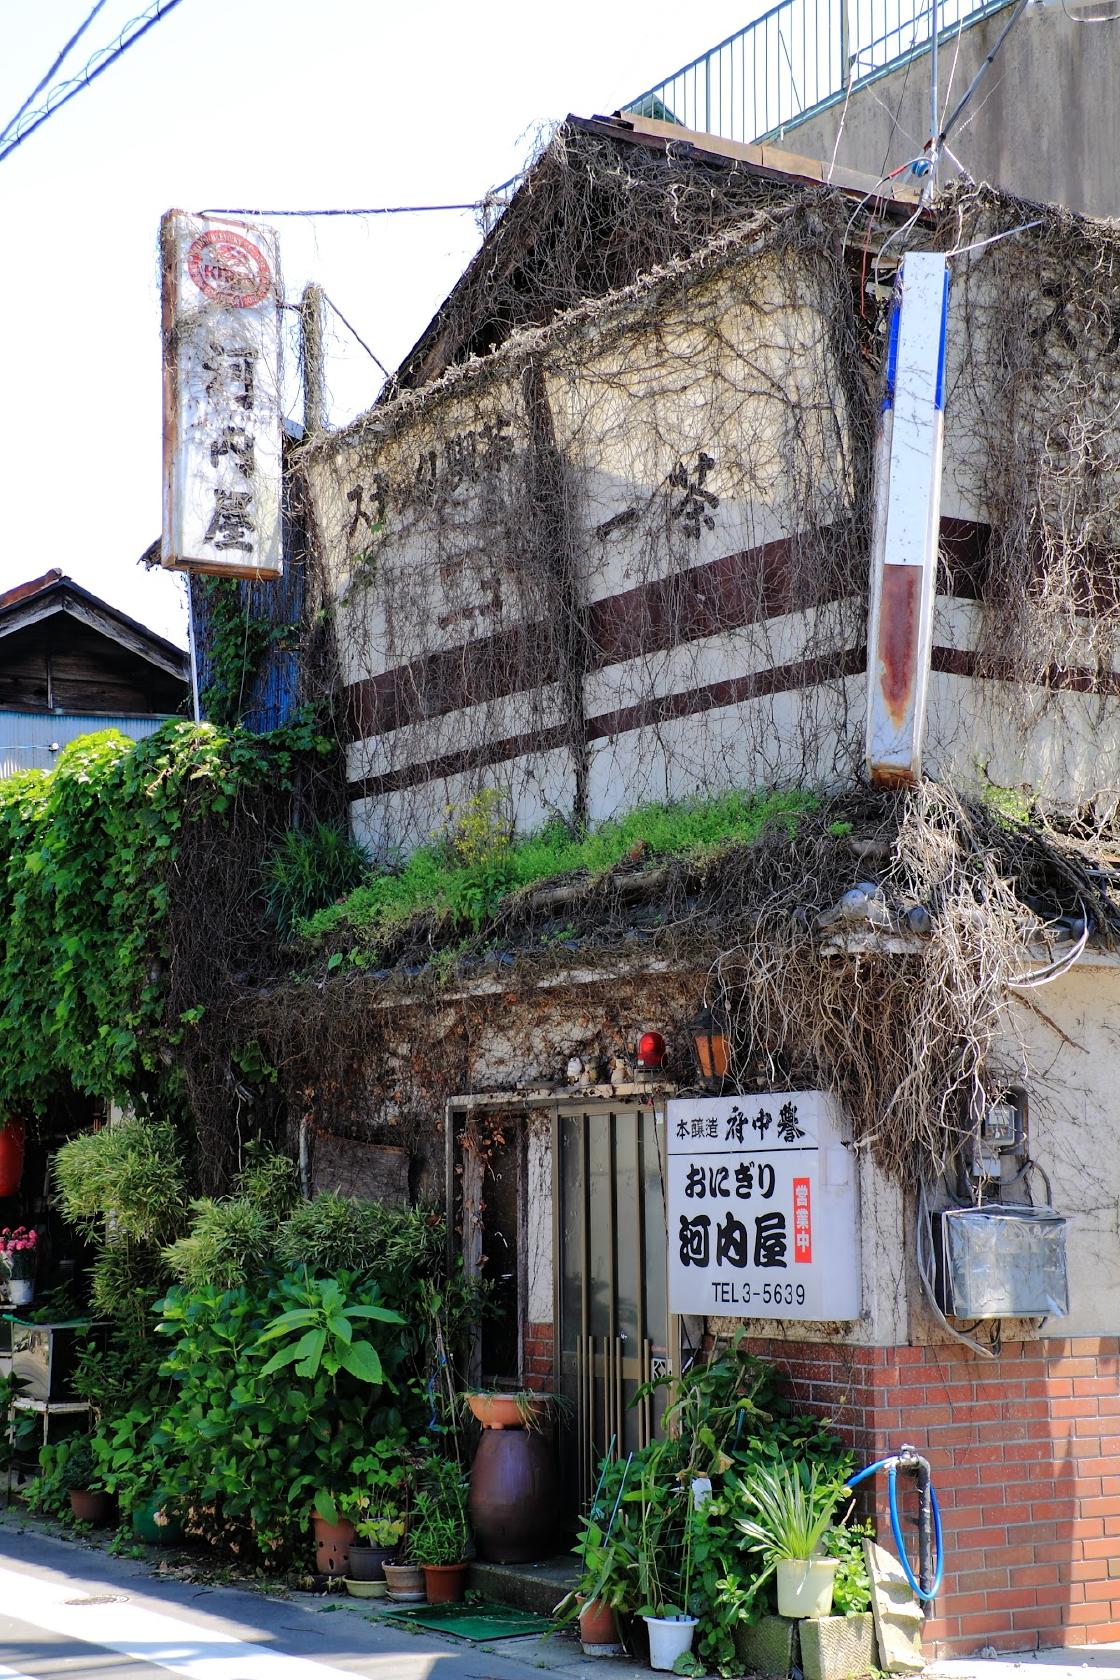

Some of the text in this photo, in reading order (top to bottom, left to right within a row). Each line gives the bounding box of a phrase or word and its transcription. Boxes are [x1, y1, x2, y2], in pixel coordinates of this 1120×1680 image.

[684, 1161, 776, 1199] おにぎり
[678, 1211, 788, 1269] 河内屋
[795, 1184, 810, 1253] 営業中
